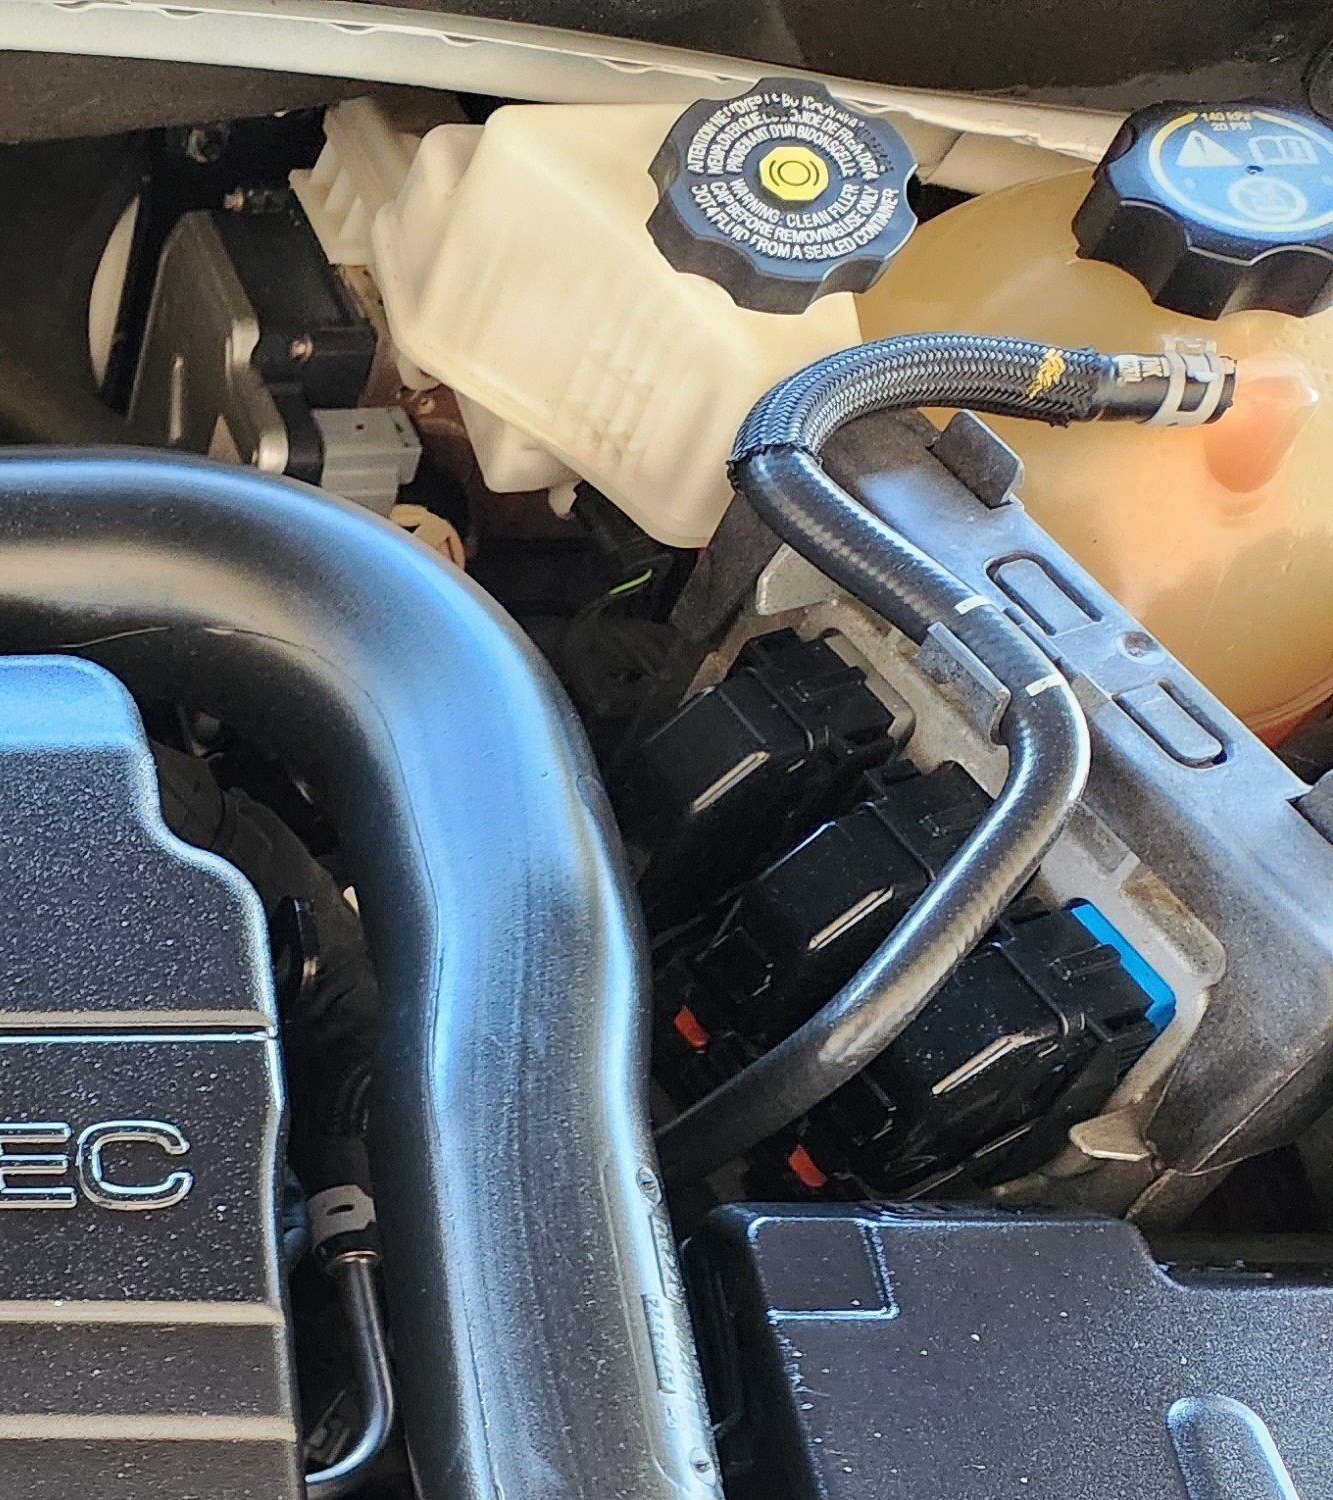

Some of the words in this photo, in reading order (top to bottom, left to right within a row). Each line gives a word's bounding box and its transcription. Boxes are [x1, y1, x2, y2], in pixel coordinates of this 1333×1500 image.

[1200, 112, 1224, 122] 140
[1211, 122, 1229, 131] 20
[1229, 122, 1252, 131] PSI
[709, 181, 736, 208] CAP
[784, 207, 833, 230] CLEAN
[825, 183, 862, 219] FILLER
[852, 185, 881, 215] ONLY
[723, 200, 775, 238] BEFORE
[791, 244, 802, 259] A
[804, 235, 857, 261] SEALED
[852, 187, 901, 246] CONTAINER
[838, 209, 867, 233] USE
